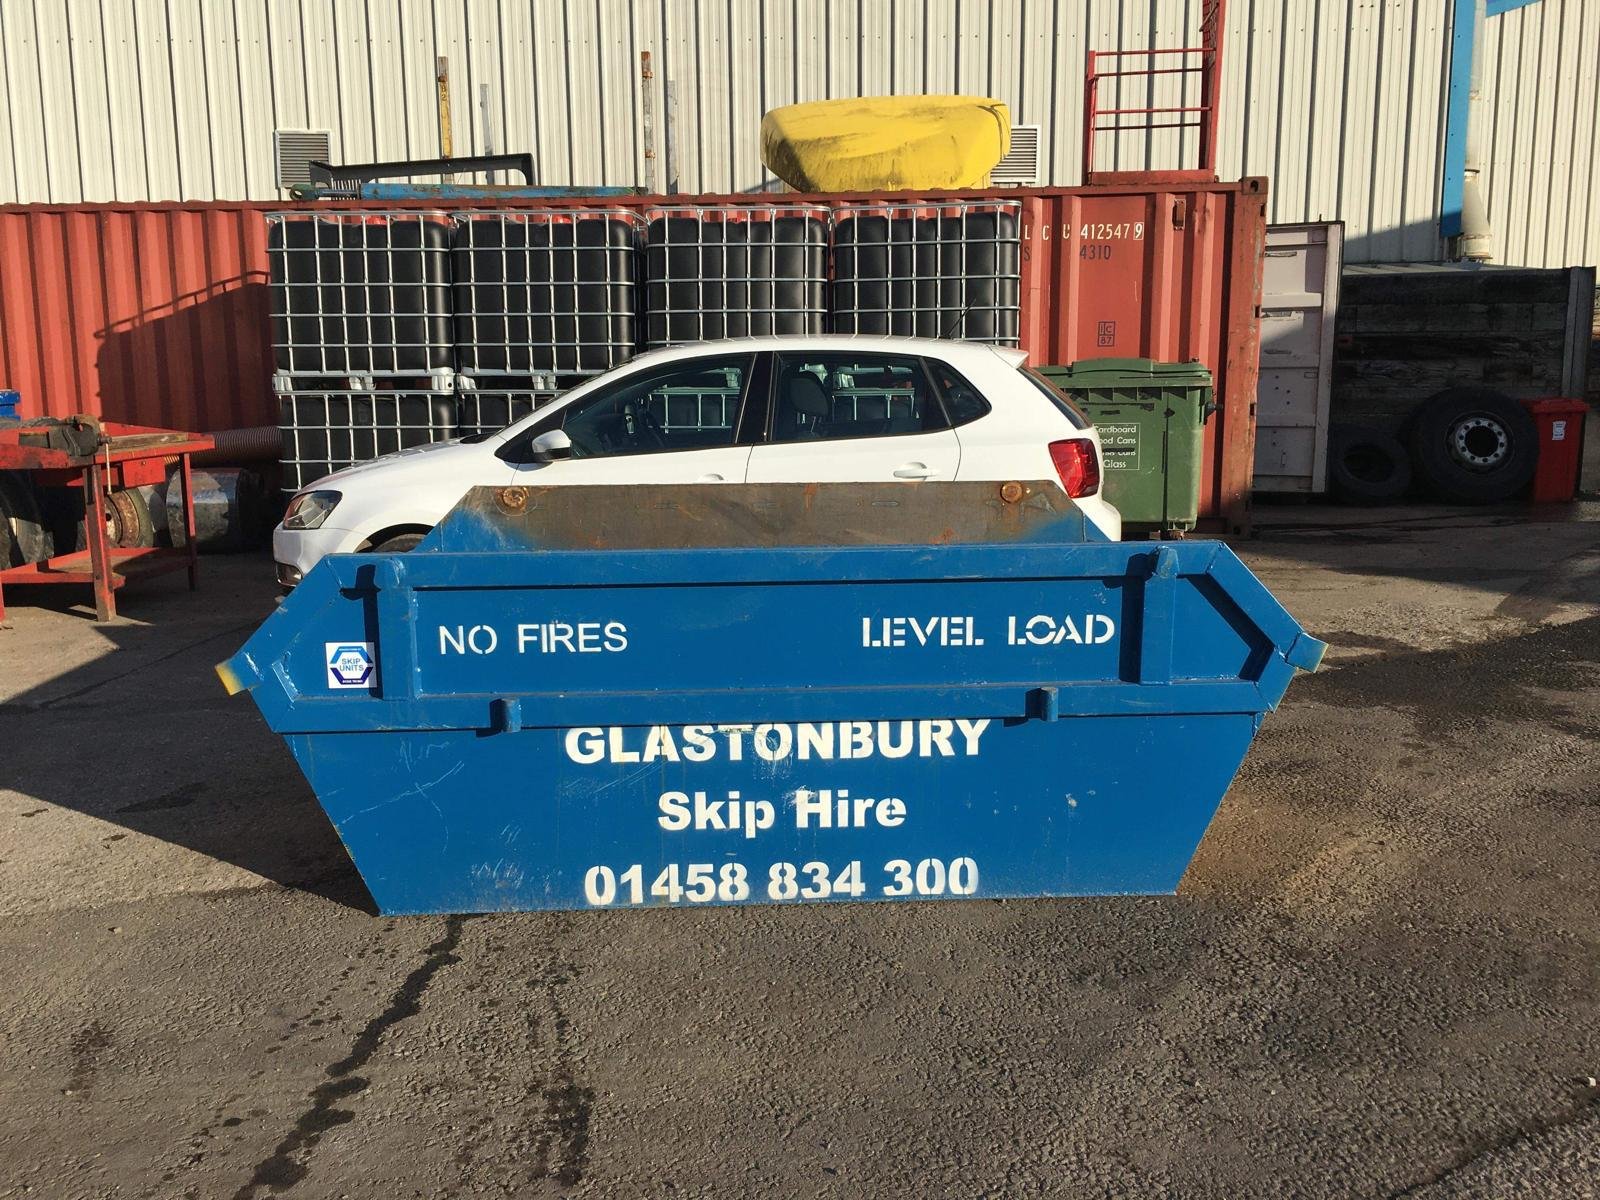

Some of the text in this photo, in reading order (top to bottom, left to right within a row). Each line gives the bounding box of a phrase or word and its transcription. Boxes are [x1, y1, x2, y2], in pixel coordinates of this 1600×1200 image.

[1080, 245, 1111, 260] 4310
[1100, 336, 1113, 345] 87
[1117, 436, 1136, 444] Cans
[1103, 459, 1126, 468] Glass
[438, 621, 628, 655] NO FIRES
[862, 614, 1115, 647] LEVEL LOAD
[565, 718, 991, 764] GLASTONBURY
[658, 789, 907, 839] Skip Hire
[584, 857, 979, 906] 01458 834 300
